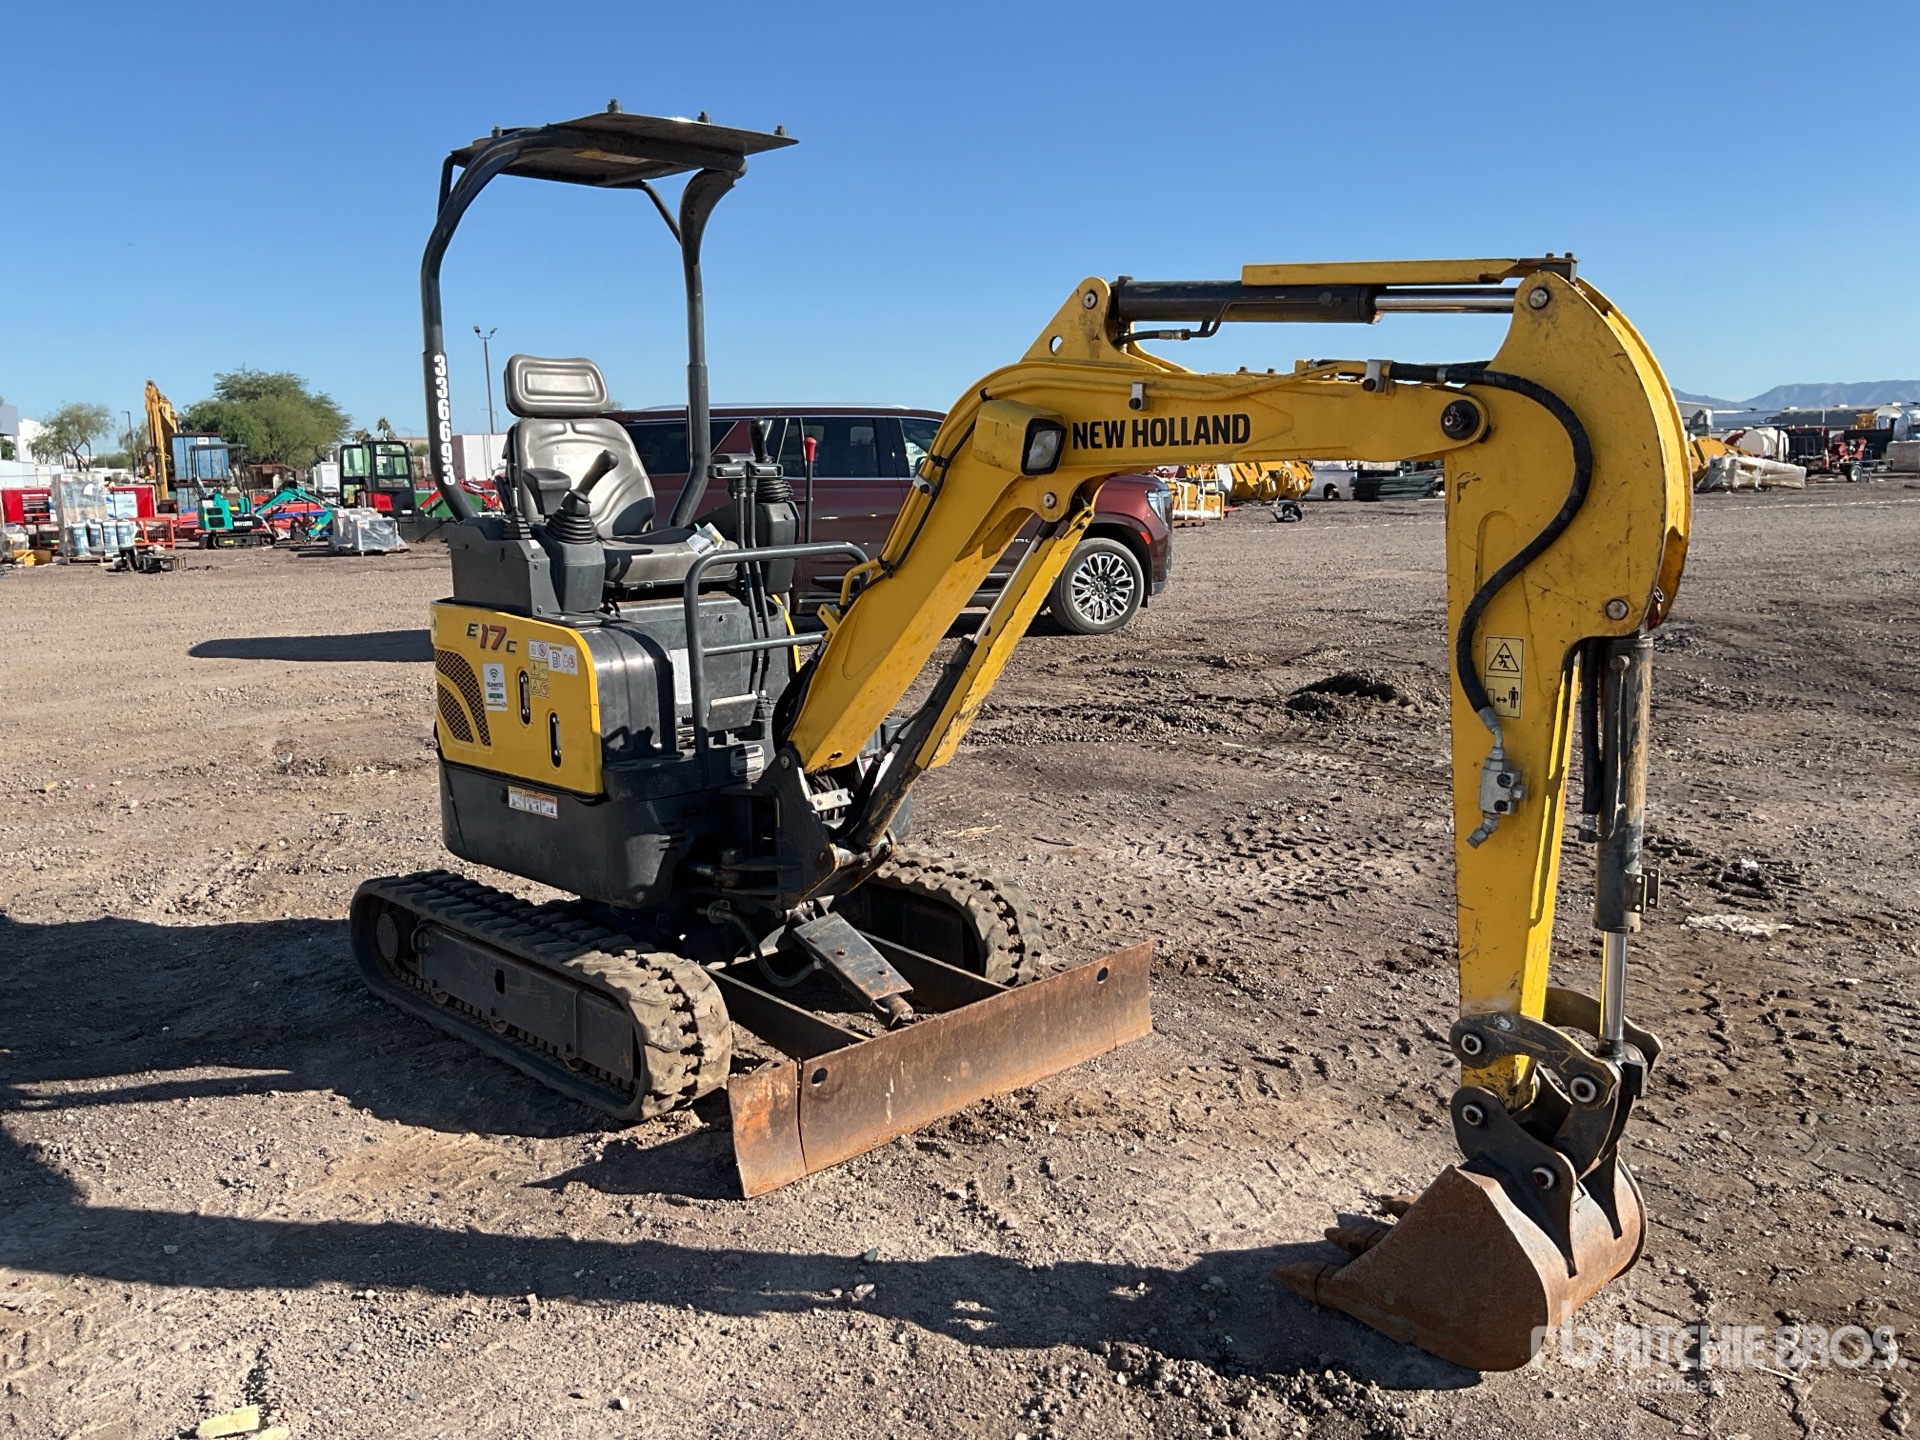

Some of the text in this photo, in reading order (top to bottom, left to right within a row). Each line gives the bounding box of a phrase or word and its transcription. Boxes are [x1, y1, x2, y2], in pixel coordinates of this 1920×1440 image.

[433, 354, 456, 486] 336693
[1072, 413, 1250, 450] NEW HOLLAND
